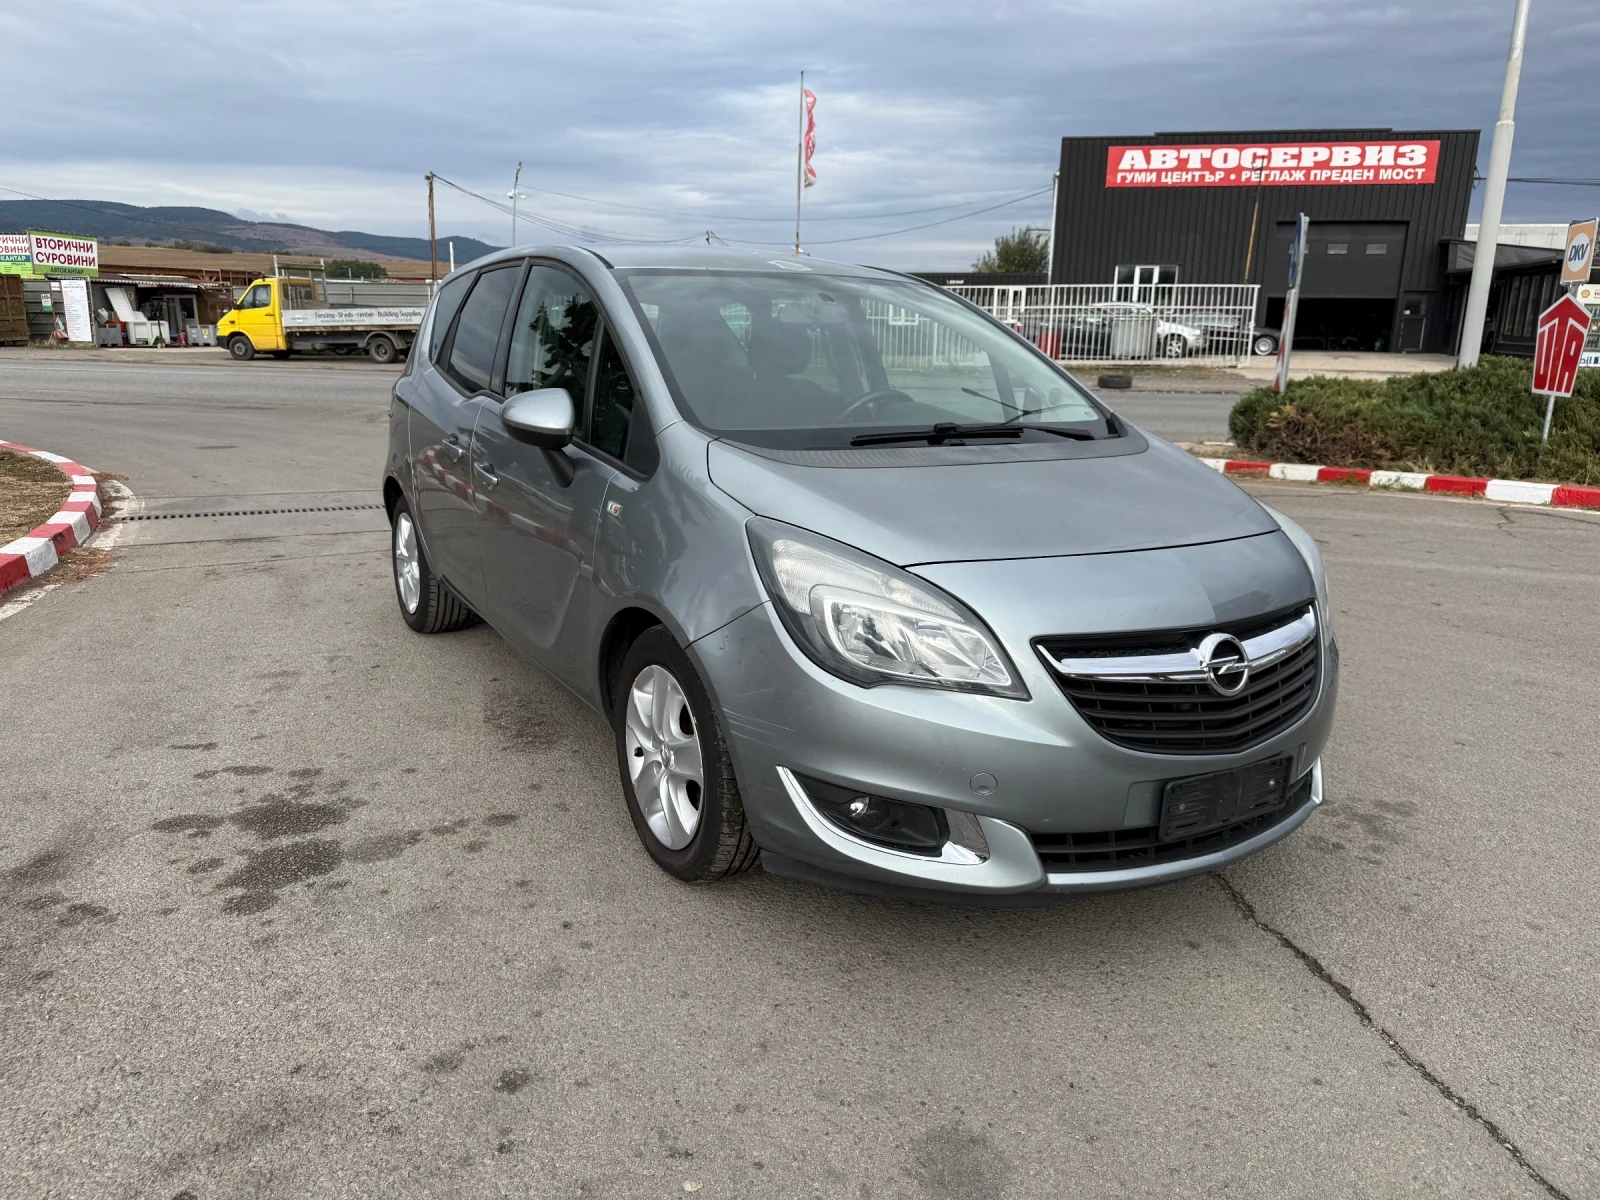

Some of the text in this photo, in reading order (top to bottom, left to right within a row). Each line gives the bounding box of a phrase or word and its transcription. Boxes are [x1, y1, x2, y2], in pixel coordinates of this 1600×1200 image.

[1118, 145, 1427, 170] АВТОСЕРВИЗ
[1117, 168, 1426, 184] ГУМИ ЦЕНТЪР РЕГЛАЖ ПРЕДЕН МОСТ
[0, 236, 28, 244] ИЧНИ
[35, 237, 94, 254] ВТОРИЧНИ
[35, 252, 96, 267] СУРОВИНИ
[1568, 242, 1589, 262] DKV
